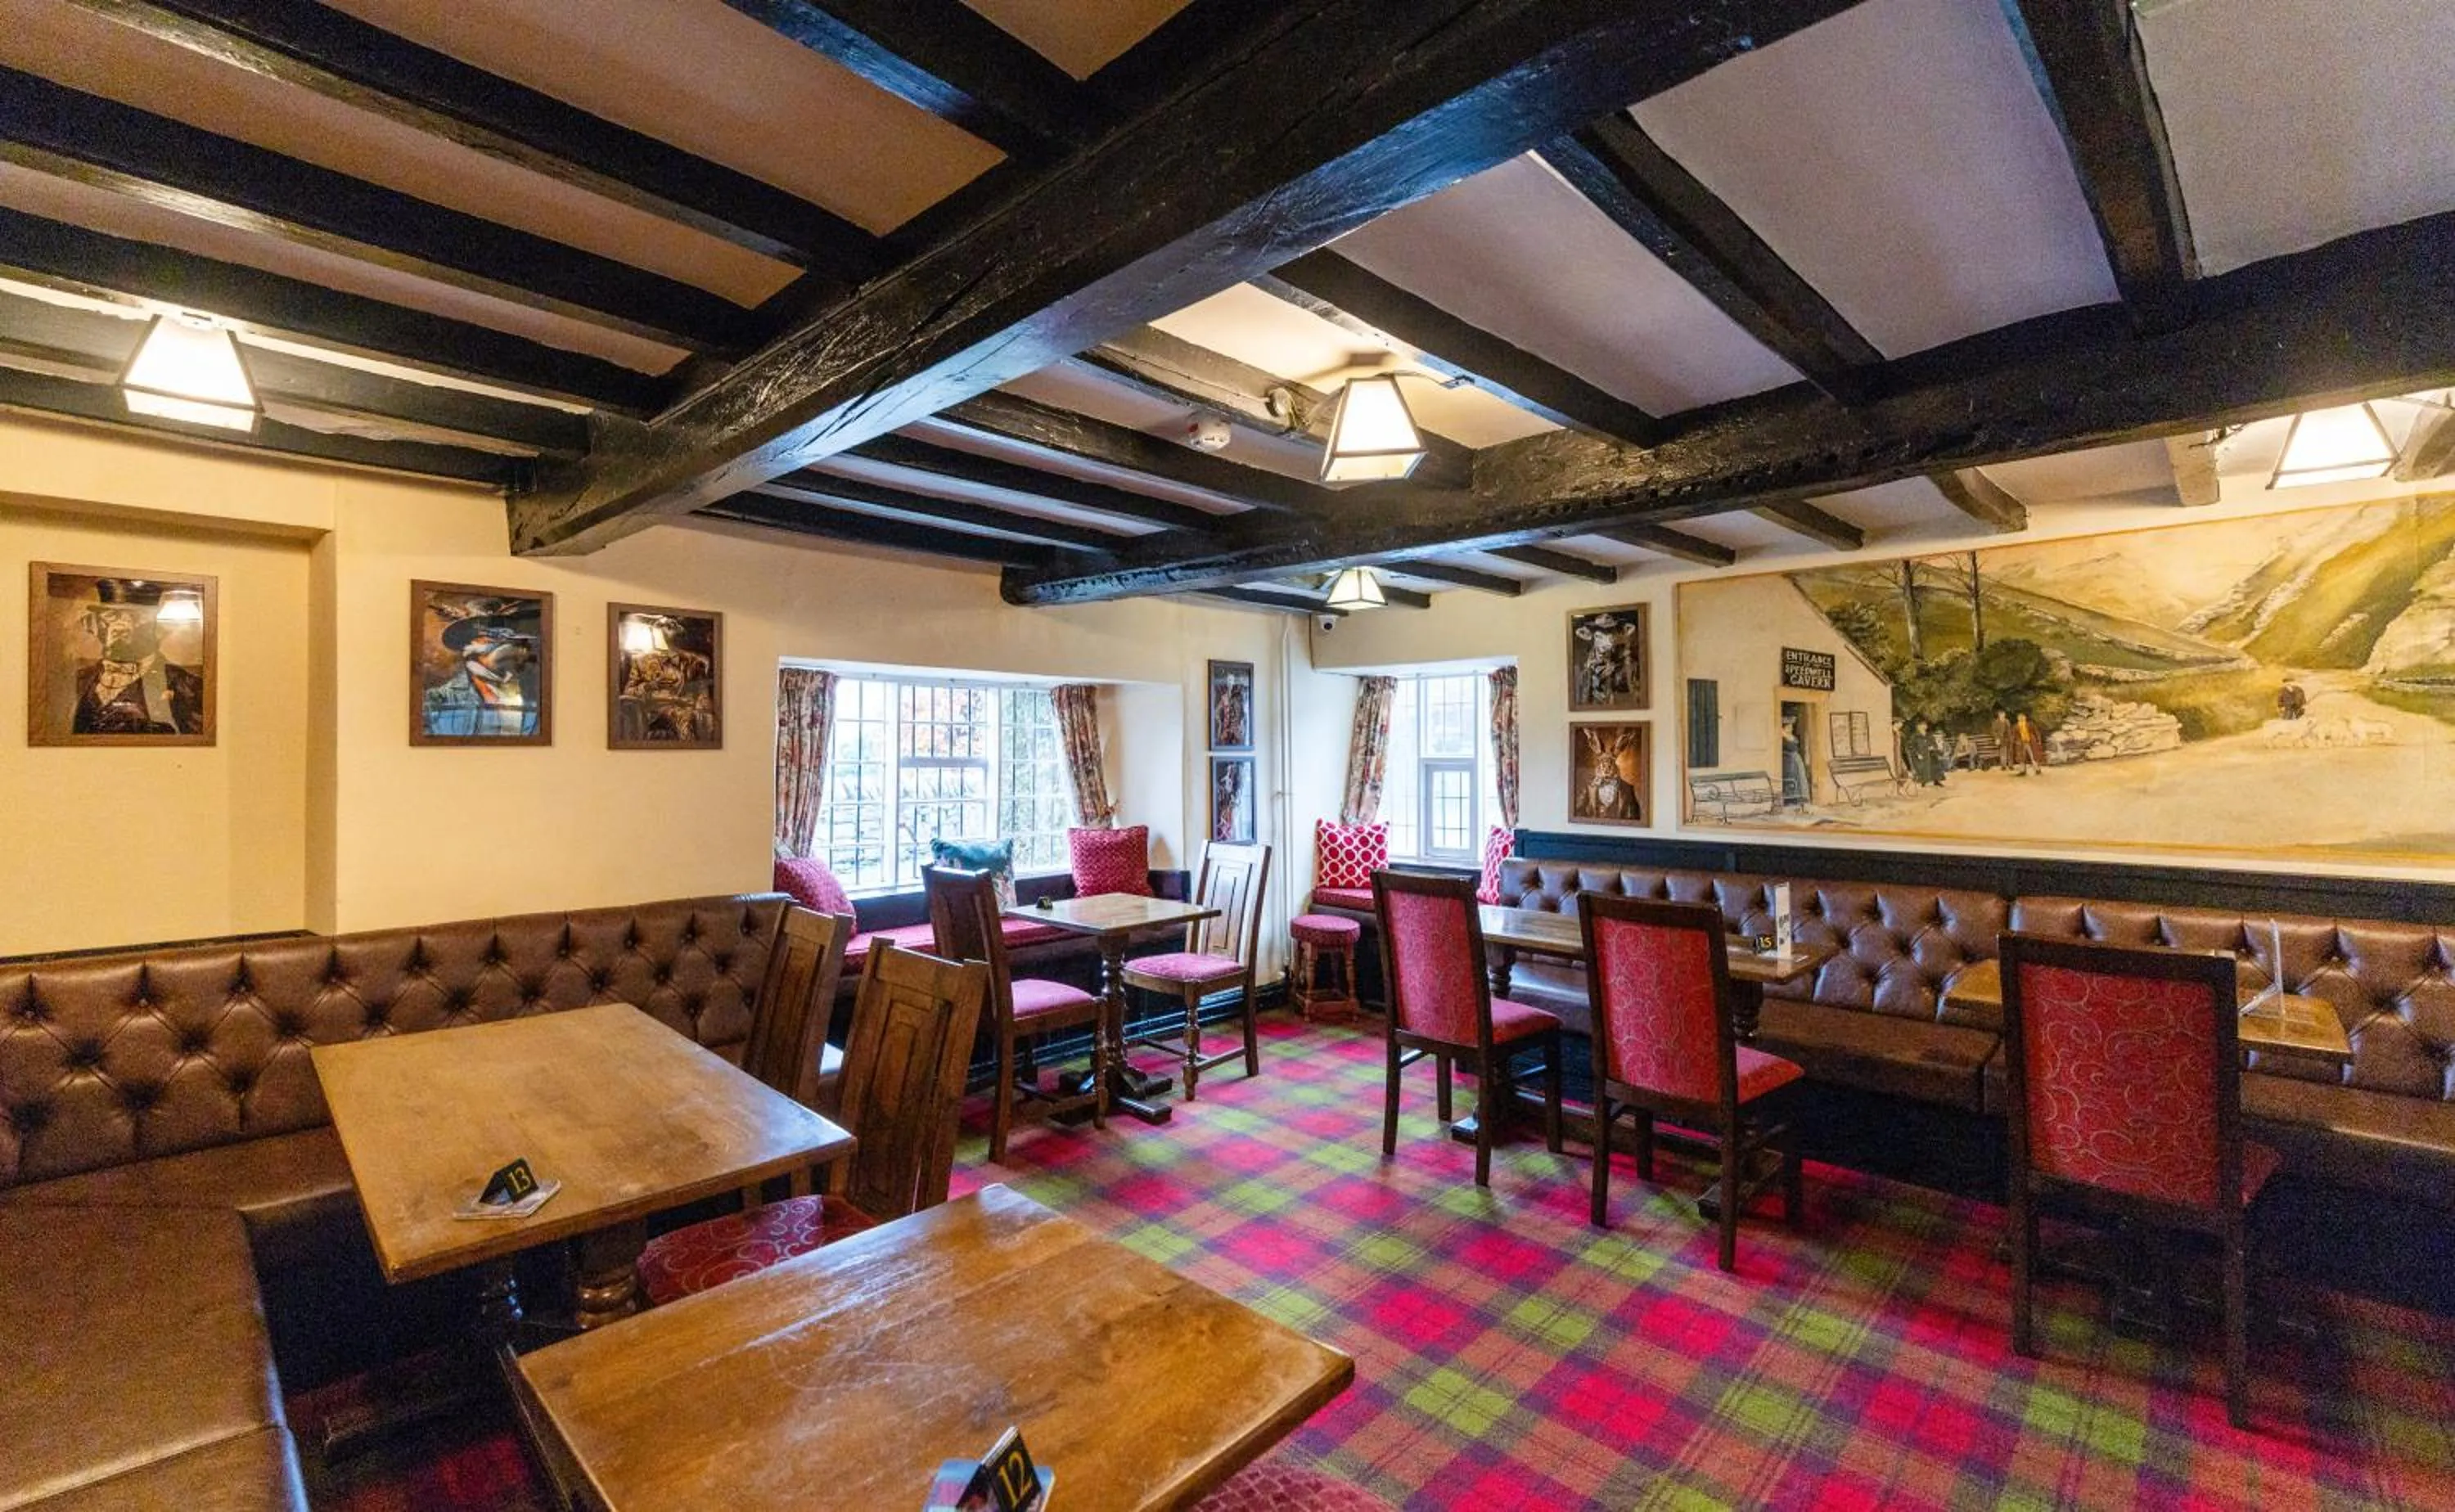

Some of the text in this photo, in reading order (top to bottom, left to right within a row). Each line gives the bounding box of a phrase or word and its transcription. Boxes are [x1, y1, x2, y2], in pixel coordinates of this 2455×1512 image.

[1790, 673, 1831, 688] CAVERN
[1759, 937, 1772, 948] 15
[507, 1166, 531, 1194] 13
[998, 1450, 1033, 1510] 12
